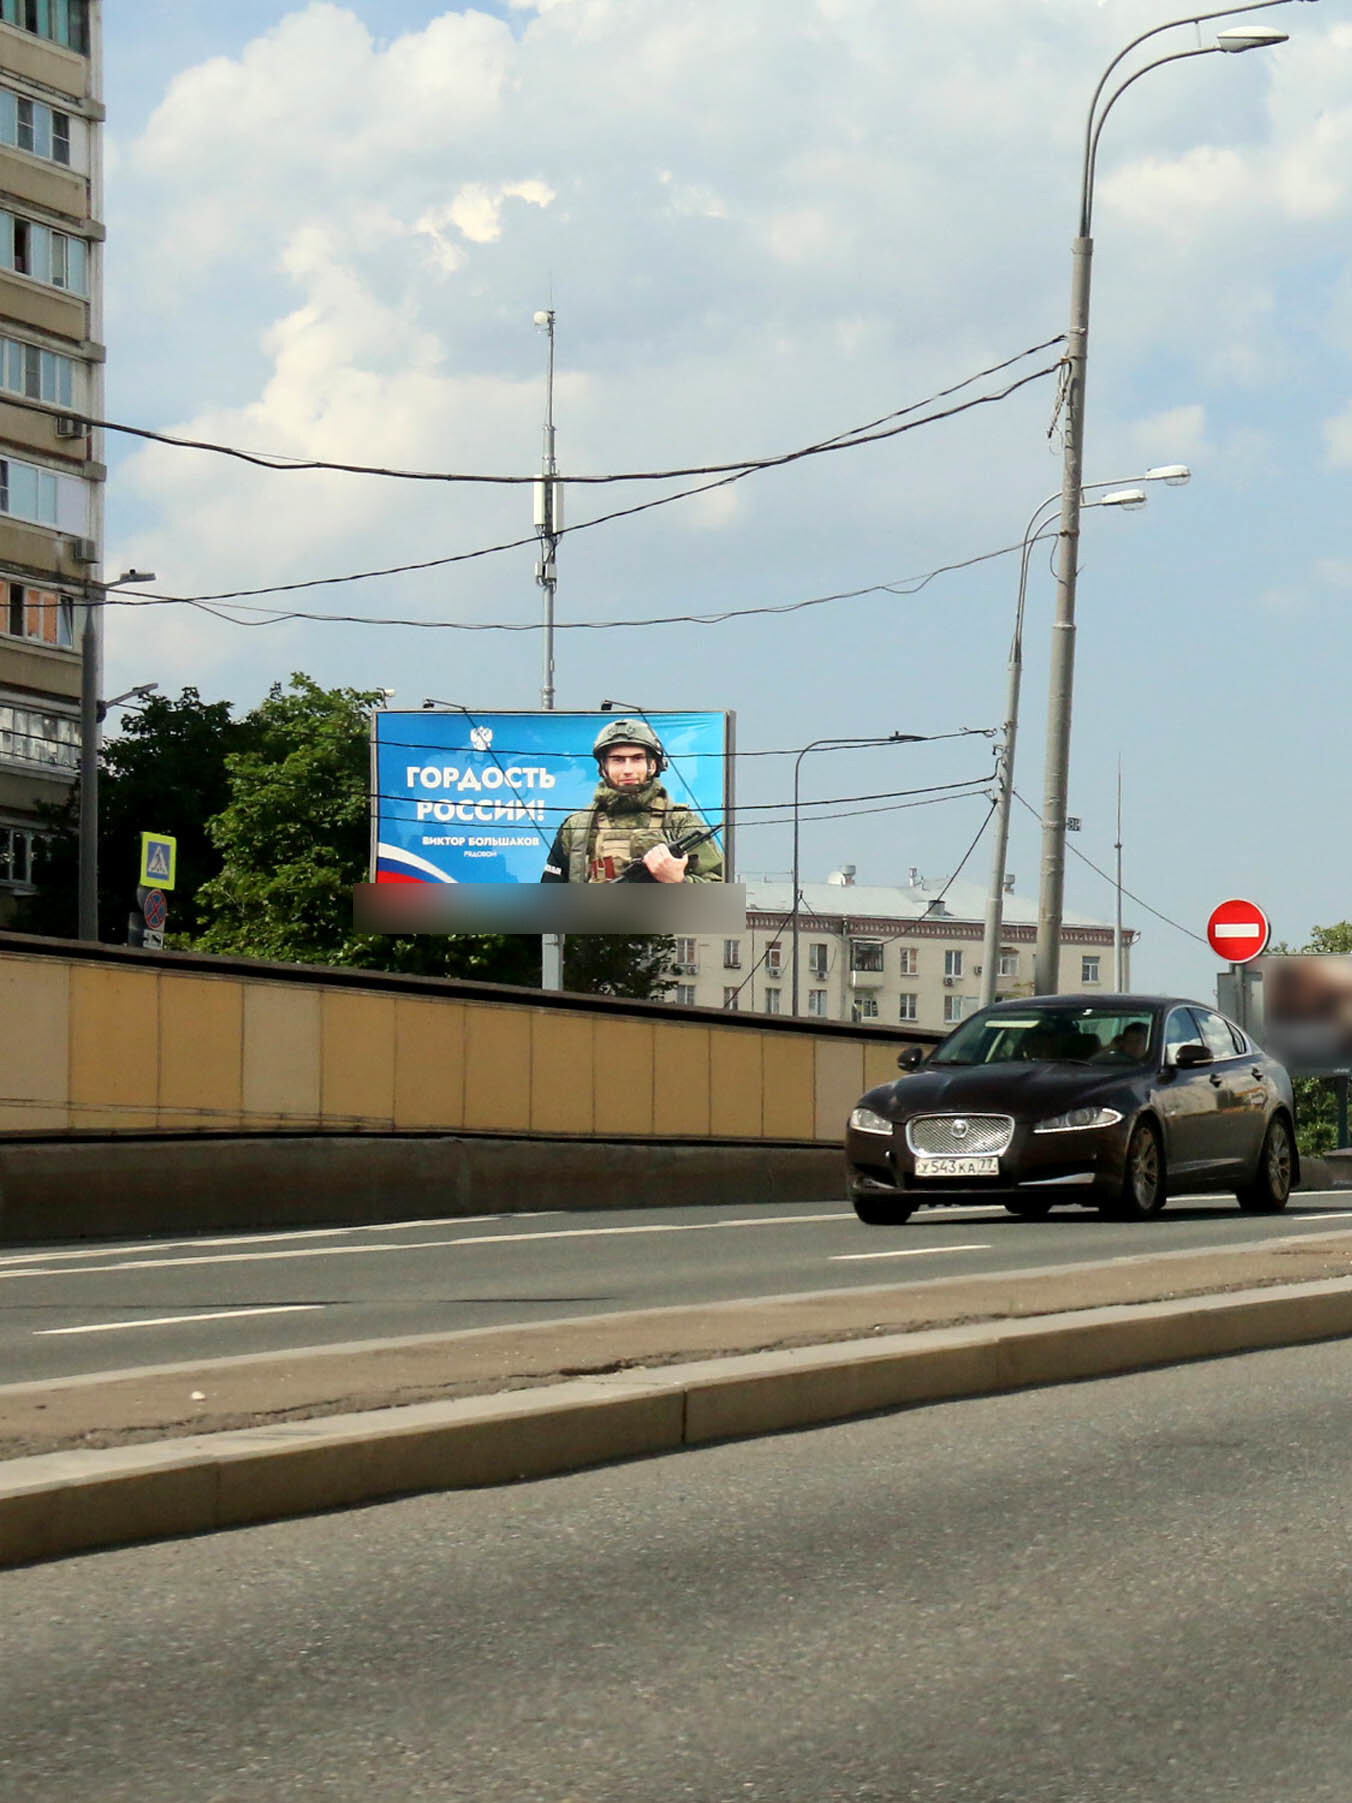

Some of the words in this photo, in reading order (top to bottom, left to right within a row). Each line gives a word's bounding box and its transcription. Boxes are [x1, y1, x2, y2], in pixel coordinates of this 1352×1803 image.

[406, 766, 556, 792] ГОРДОСТЬ
[416, 799, 545, 821] РОССИИ!
[422, 836, 466, 846] ВИКТОР
[468, 837, 540, 846] БОЛЬШАКОВ
